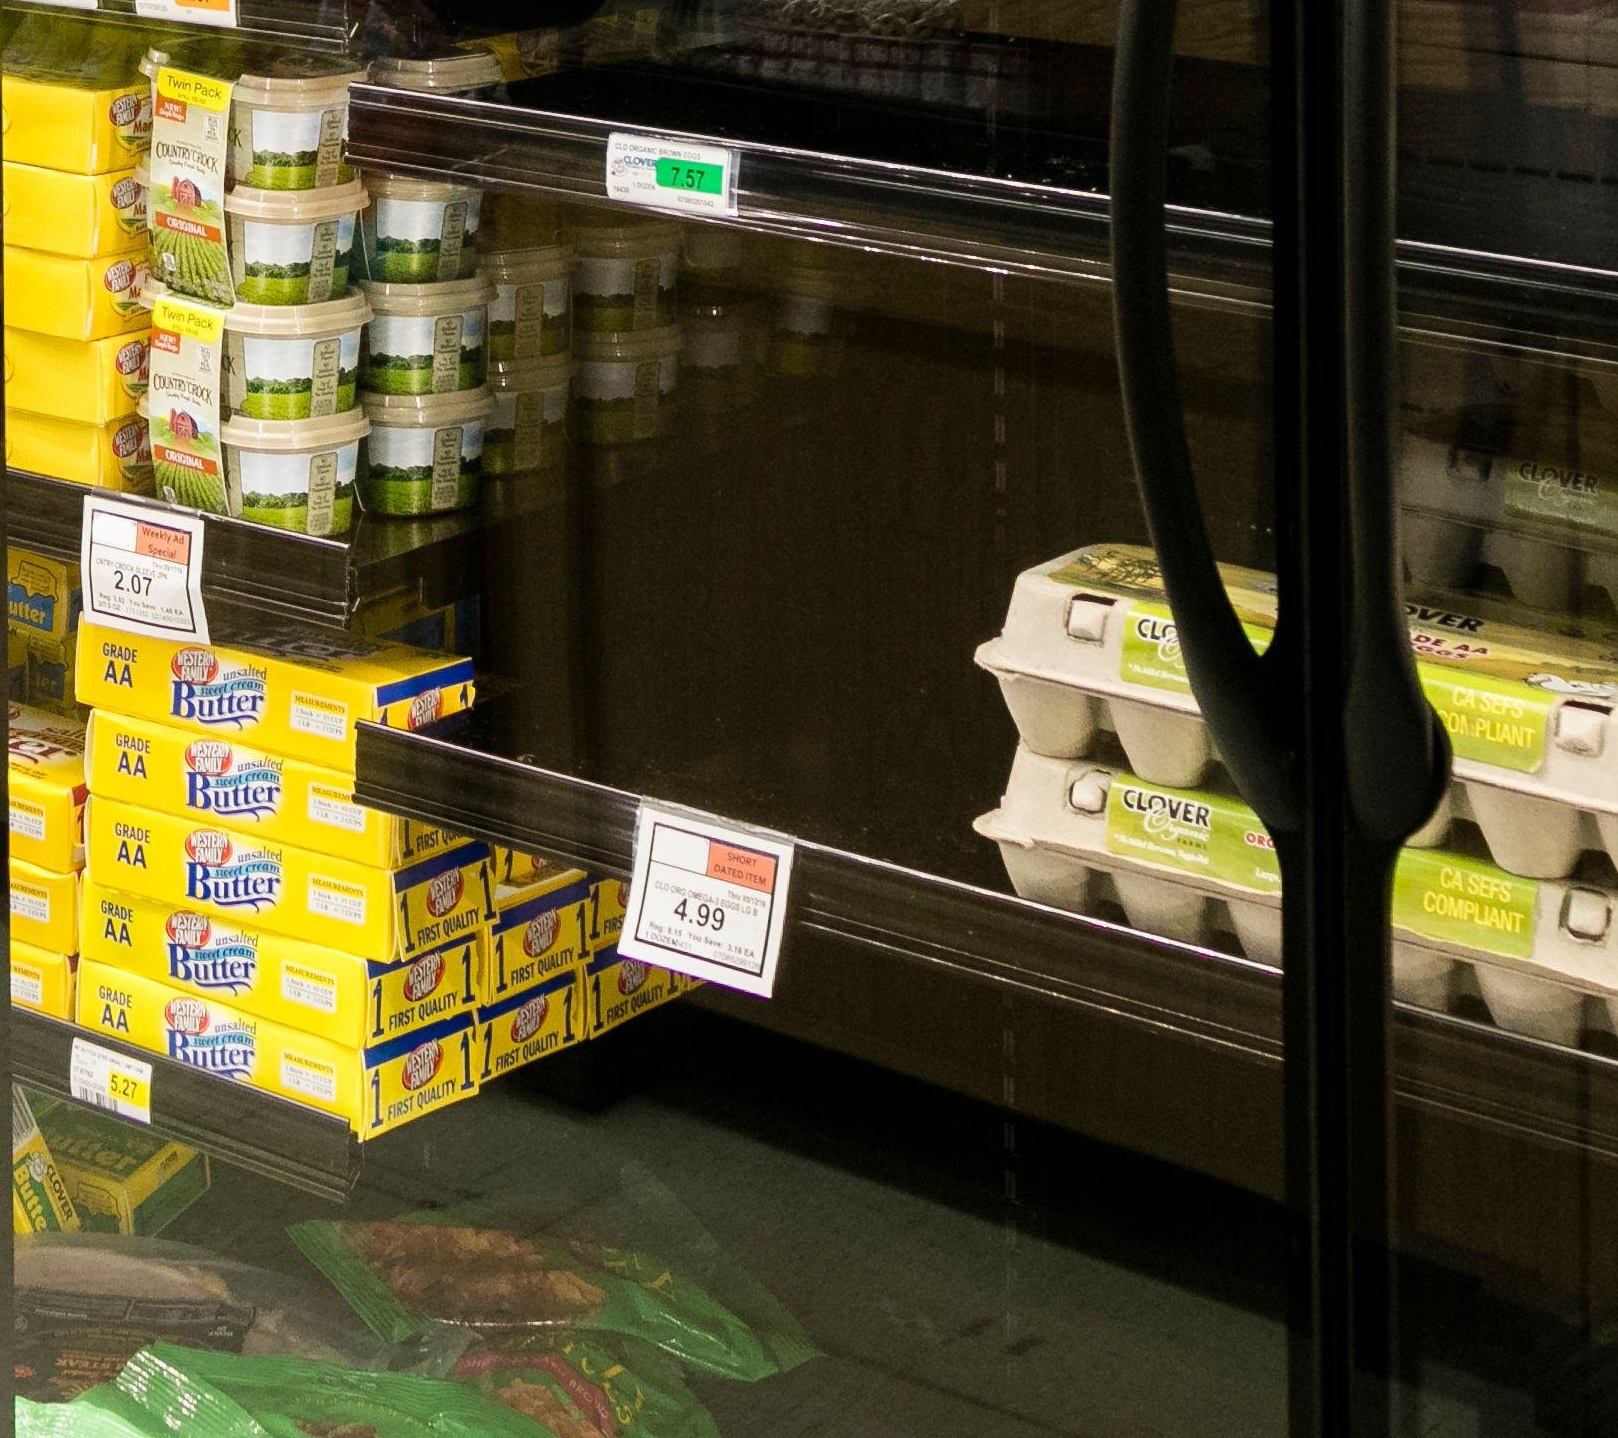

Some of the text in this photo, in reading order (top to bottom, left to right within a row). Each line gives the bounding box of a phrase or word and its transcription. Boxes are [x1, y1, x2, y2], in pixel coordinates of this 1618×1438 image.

[166, 74, 222, 101] Twin Pack
[671, 167, 705, 190] 7.57
[166, 216, 207, 237] ORIGINAL
[142, 526, 184, 544] Weekly Ad
[148, 543, 176, 559] Special
[114, 571, 152, 596] 2.07
[103, 642, 138, 663] GRADE
[104, 660, 133, 688] AA
[223, 664, 267, 681] unsalted
[170, 680, 264, 719] Butter
[1123, 788, 1211, 829] CLOVER
[726, 853, 758, 867] SHORT
[713, 863, 767, 886] DATED ITEM
[1440, 868, 1513, 903] CA SEFS
[674, 898, 726, 931] 4.99
[1423, 890, 1524, 935] COMPLIANT
[109, 1073, 139, 1100] 5.27
